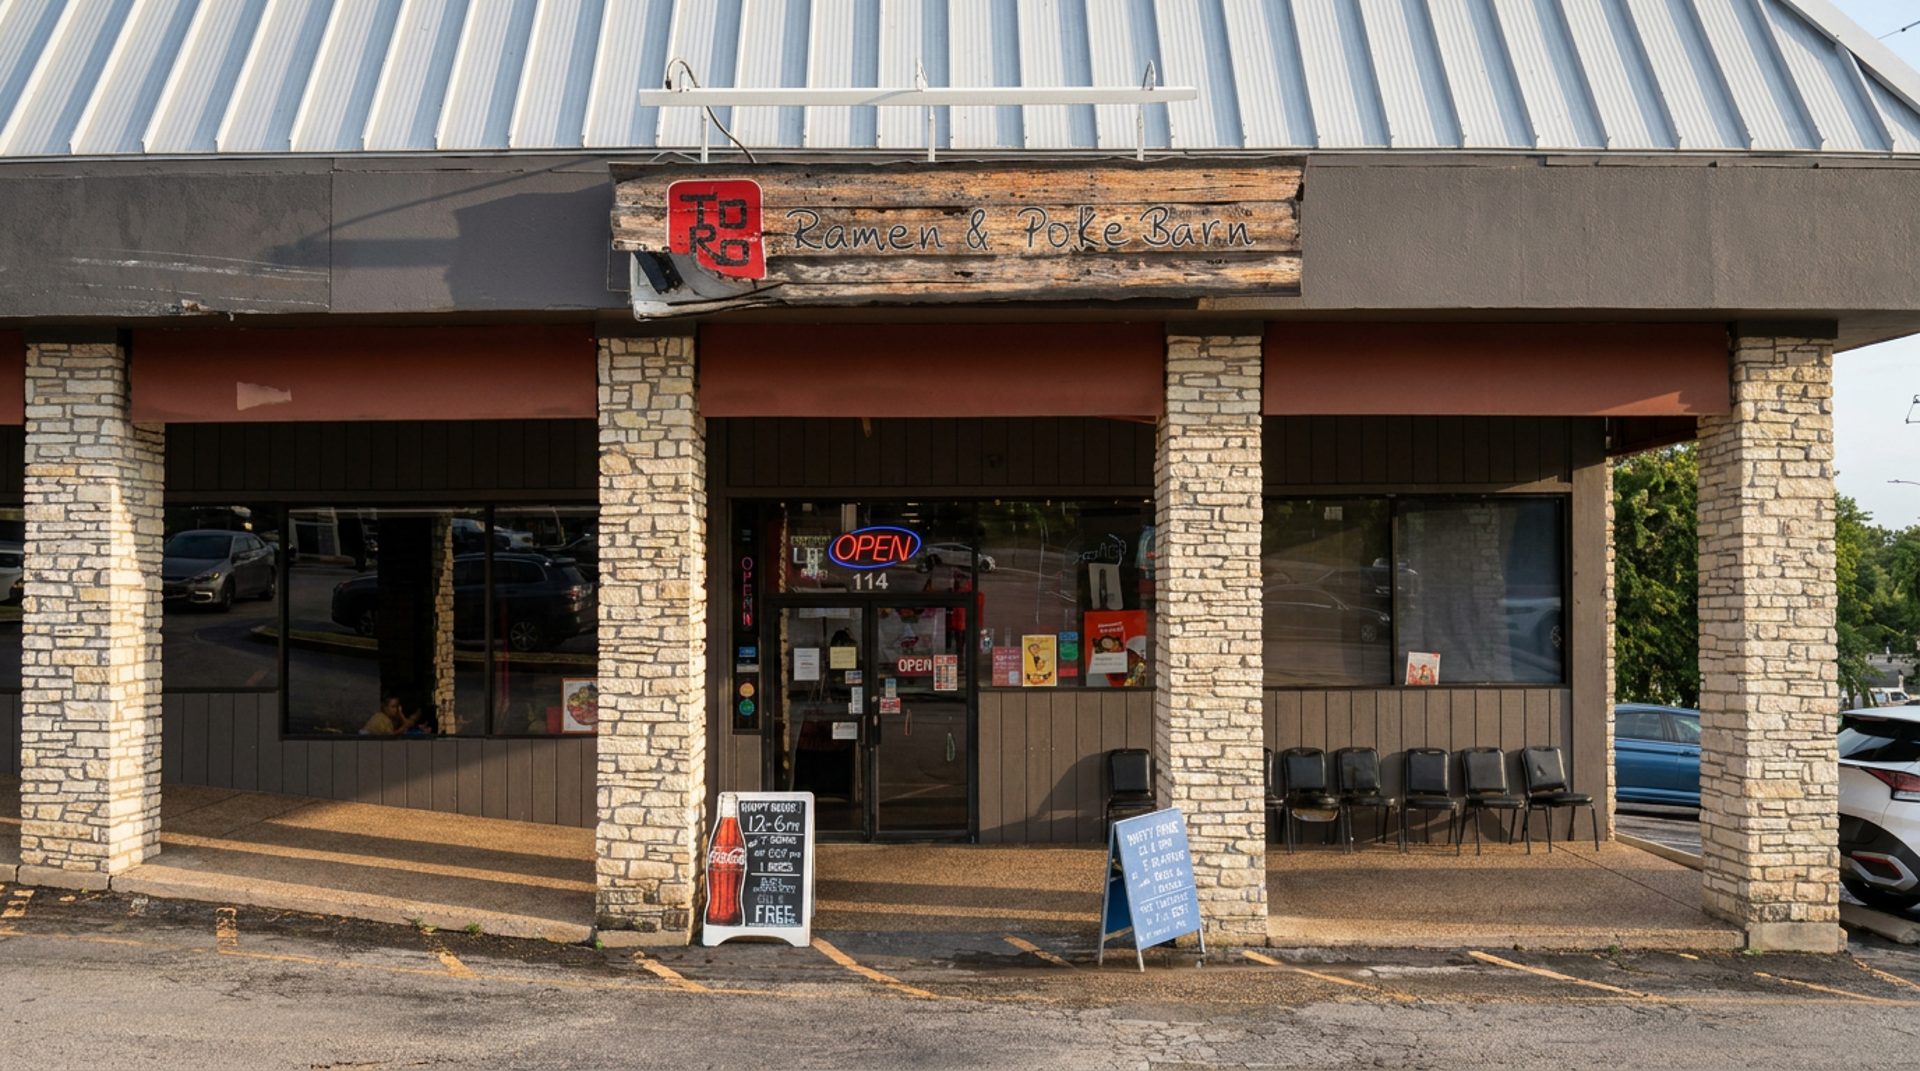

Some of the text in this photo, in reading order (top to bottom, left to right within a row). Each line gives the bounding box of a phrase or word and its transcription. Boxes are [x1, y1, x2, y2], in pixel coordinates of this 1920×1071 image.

[786, 207, 945, 252] Ramen
[965, 207, 990, 251] &
[1139, 206, 1257, 247] Barn
[835, 533, 912, 562] OPEN
[853, 572, 889, 590] 114
[897, 658, 933, 672] OPEN
